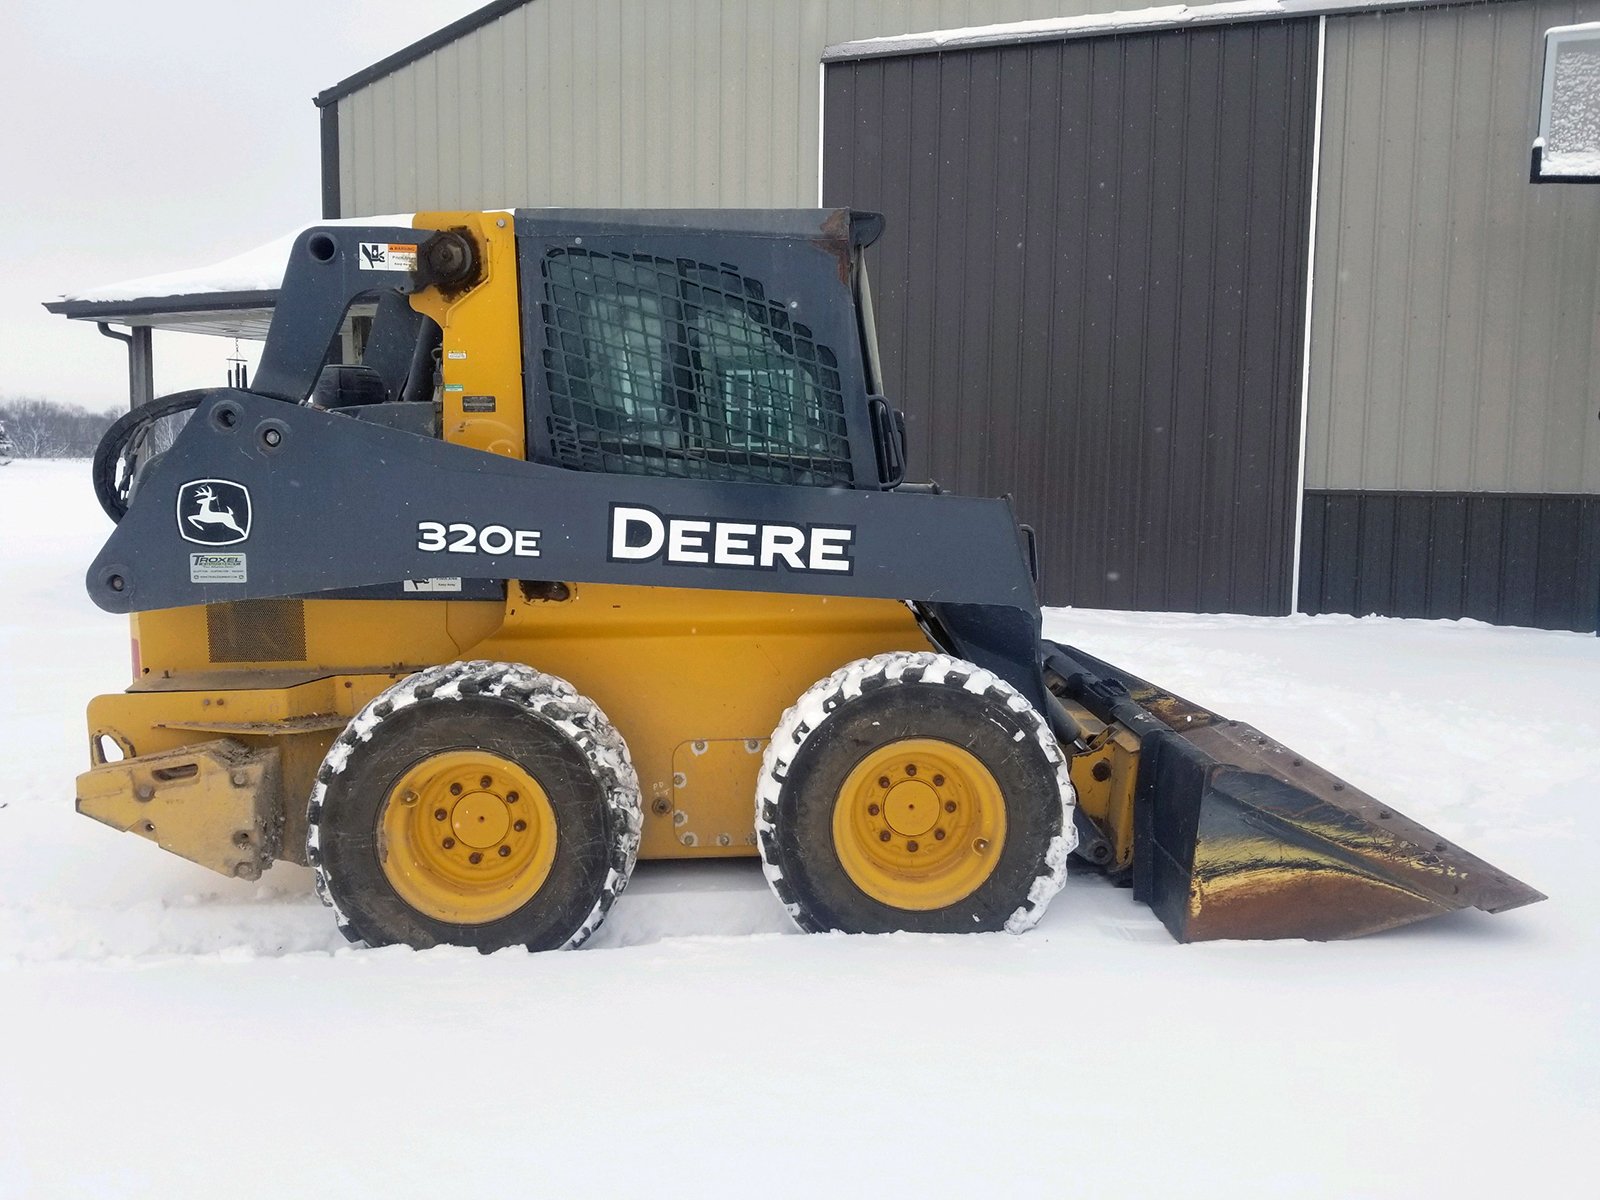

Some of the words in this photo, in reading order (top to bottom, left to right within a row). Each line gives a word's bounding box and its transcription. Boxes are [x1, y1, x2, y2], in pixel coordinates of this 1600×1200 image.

[418, 521, 541, 557] 320E
[612, 506, 852, 571] DEERE
[192, 555, 242, 566] TROXEL
